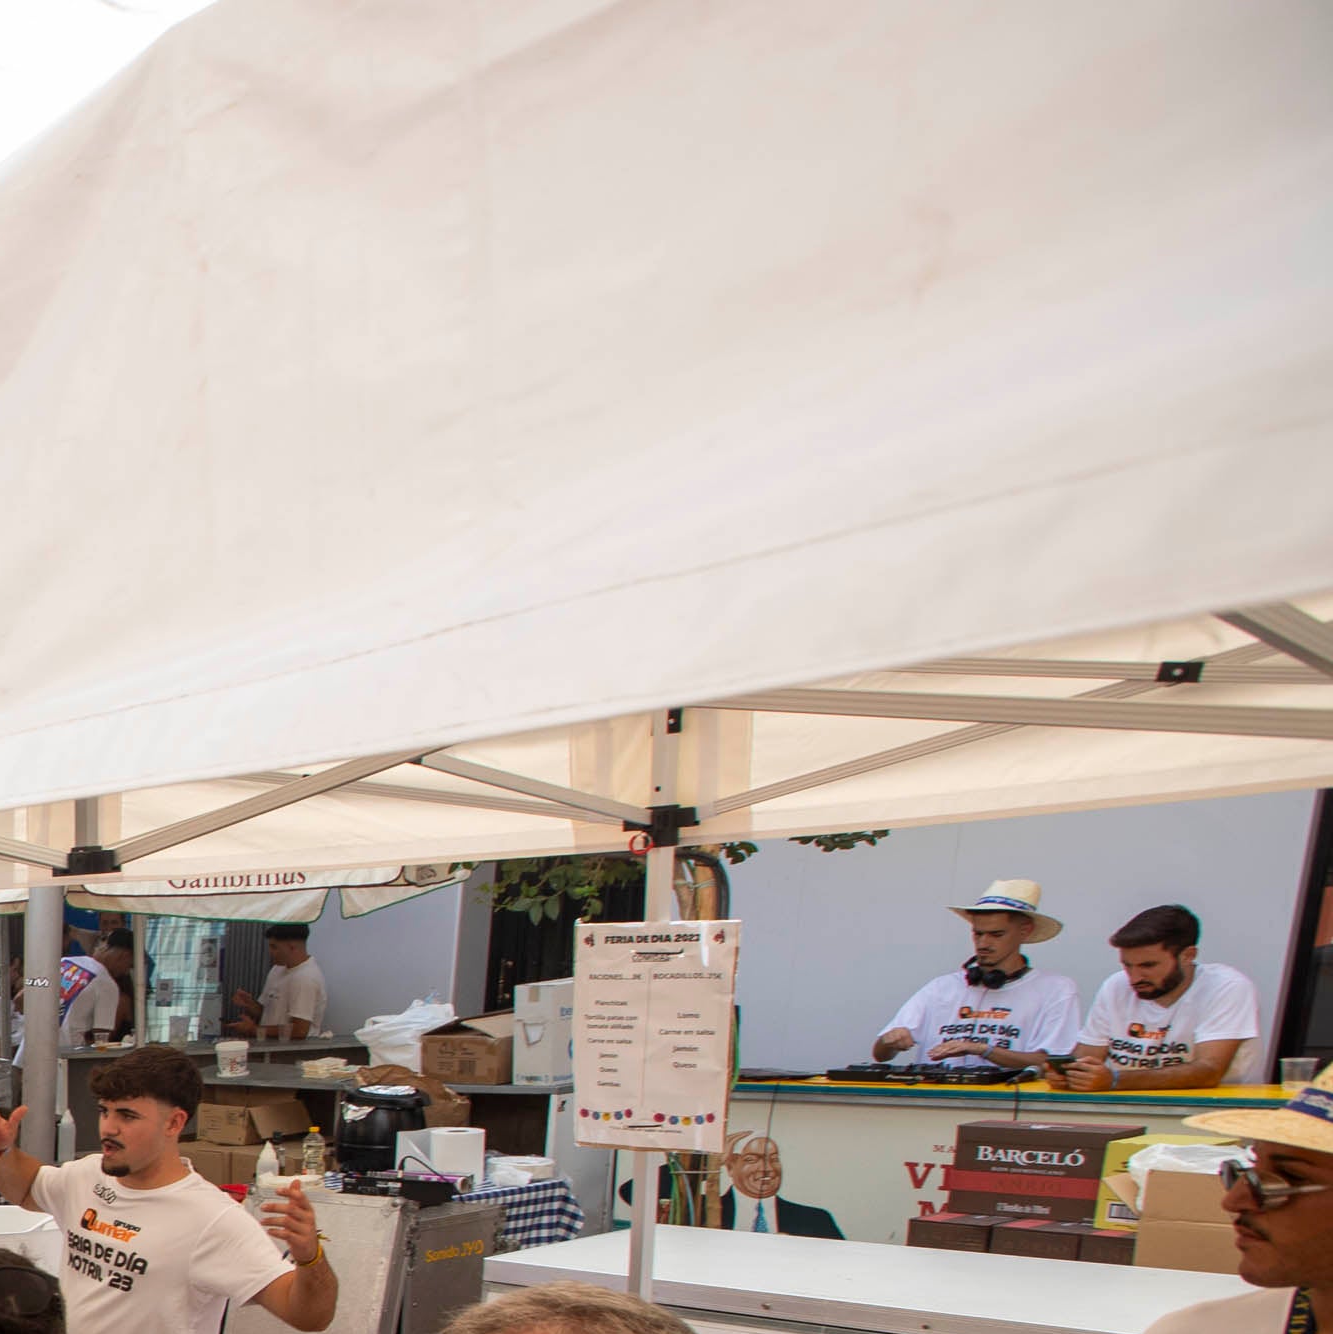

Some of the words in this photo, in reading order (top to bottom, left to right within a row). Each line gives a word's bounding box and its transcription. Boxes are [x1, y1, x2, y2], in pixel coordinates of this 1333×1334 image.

[604, 934, 633, 944] FERIA
[636, 934, 648, 943] DE
[651, 934, 671, 943] DIA
[976, 1145, 1085, 1166] BARCELÓ
[94, 1242, 113, 1263] DE
[114, 1251, 148, 1275] DÍA
